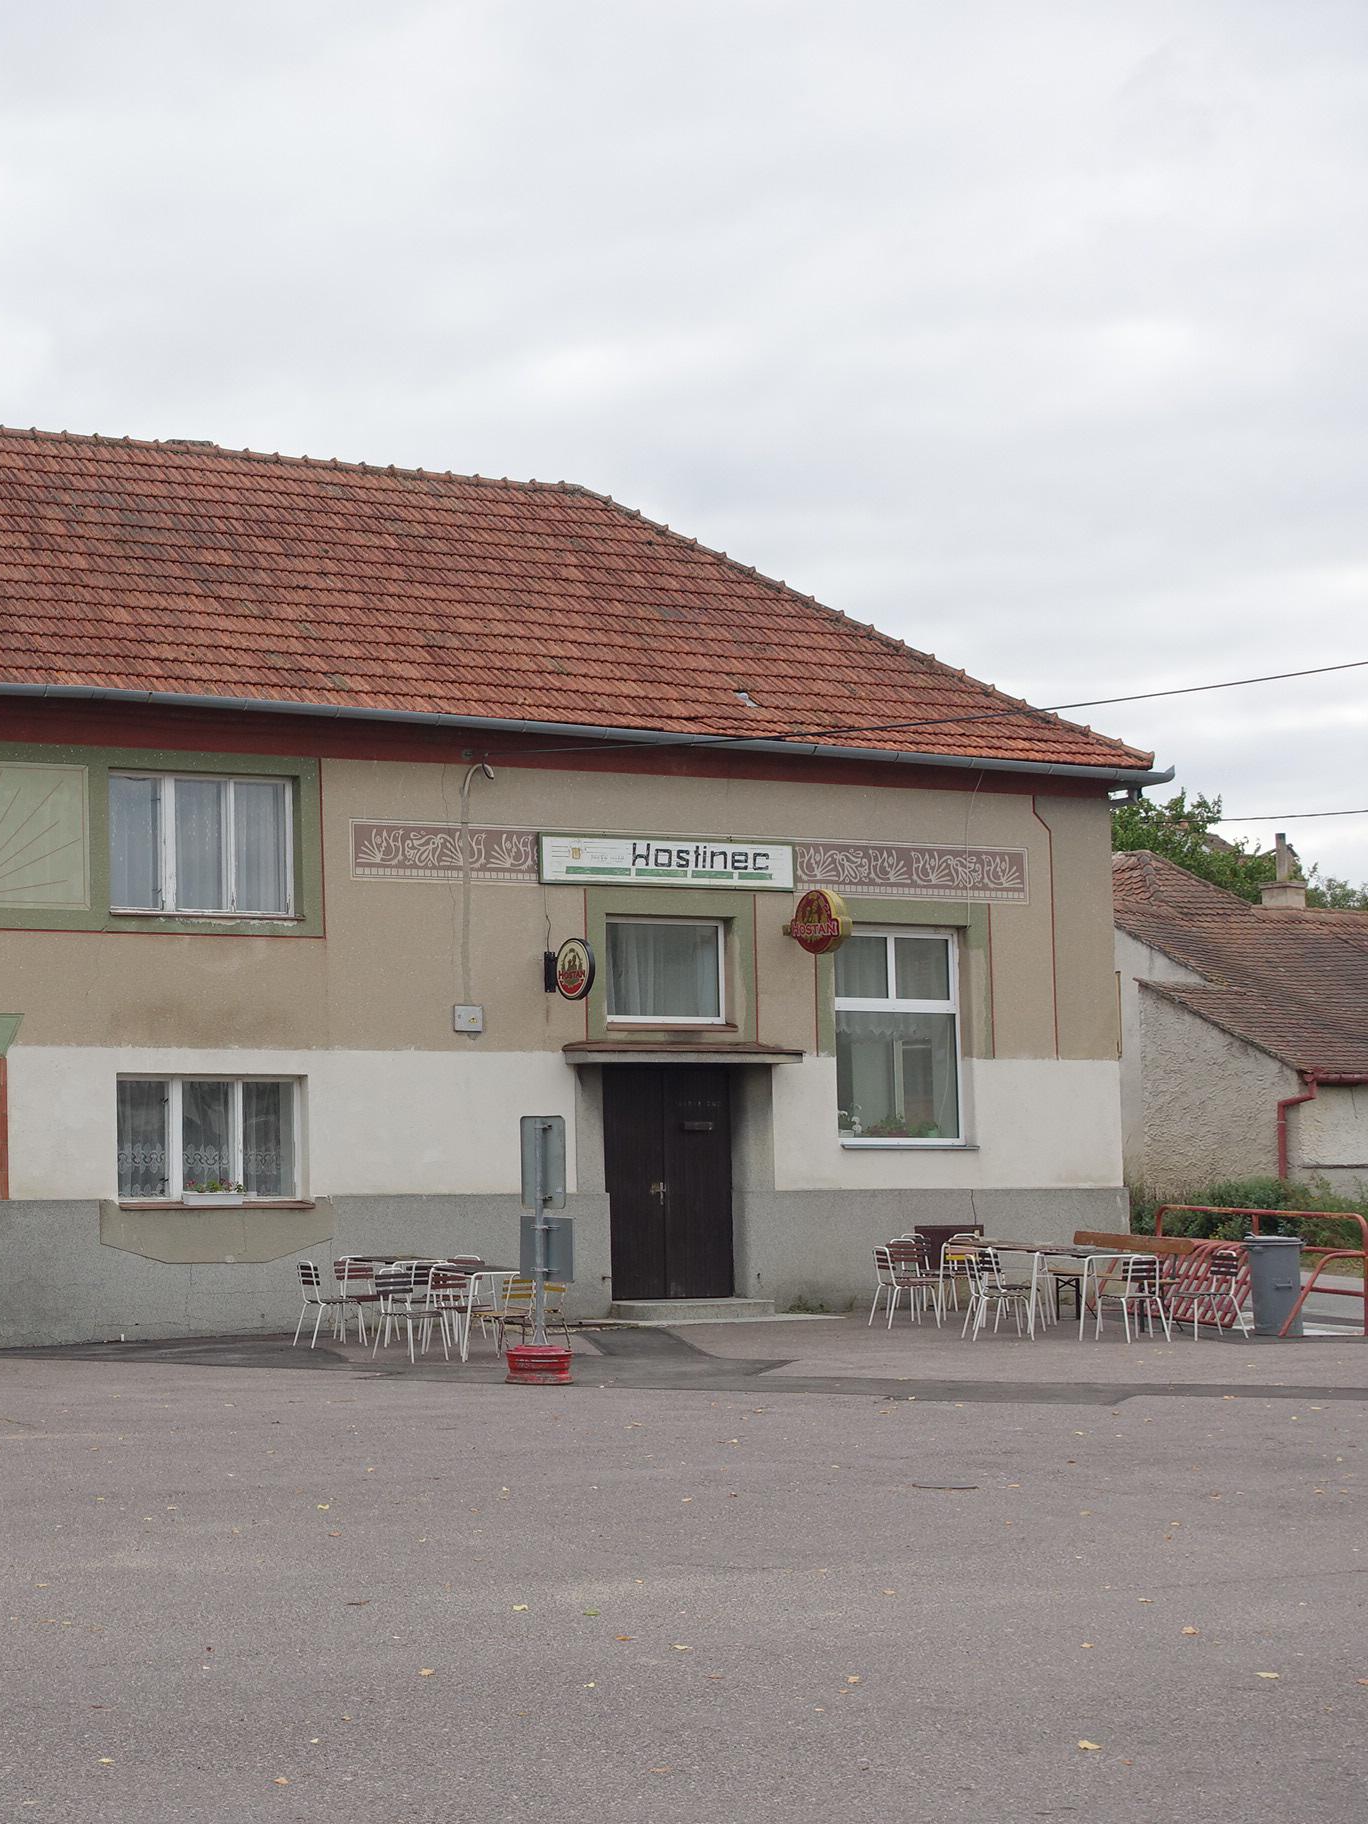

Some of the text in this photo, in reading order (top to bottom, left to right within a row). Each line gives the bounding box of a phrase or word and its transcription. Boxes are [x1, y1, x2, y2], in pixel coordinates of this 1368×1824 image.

[632, 842, 770, 870] Hostinec
[791, 921, 838, 937] HOSTAN
[558, 969, 586, 981] HOSTAN
